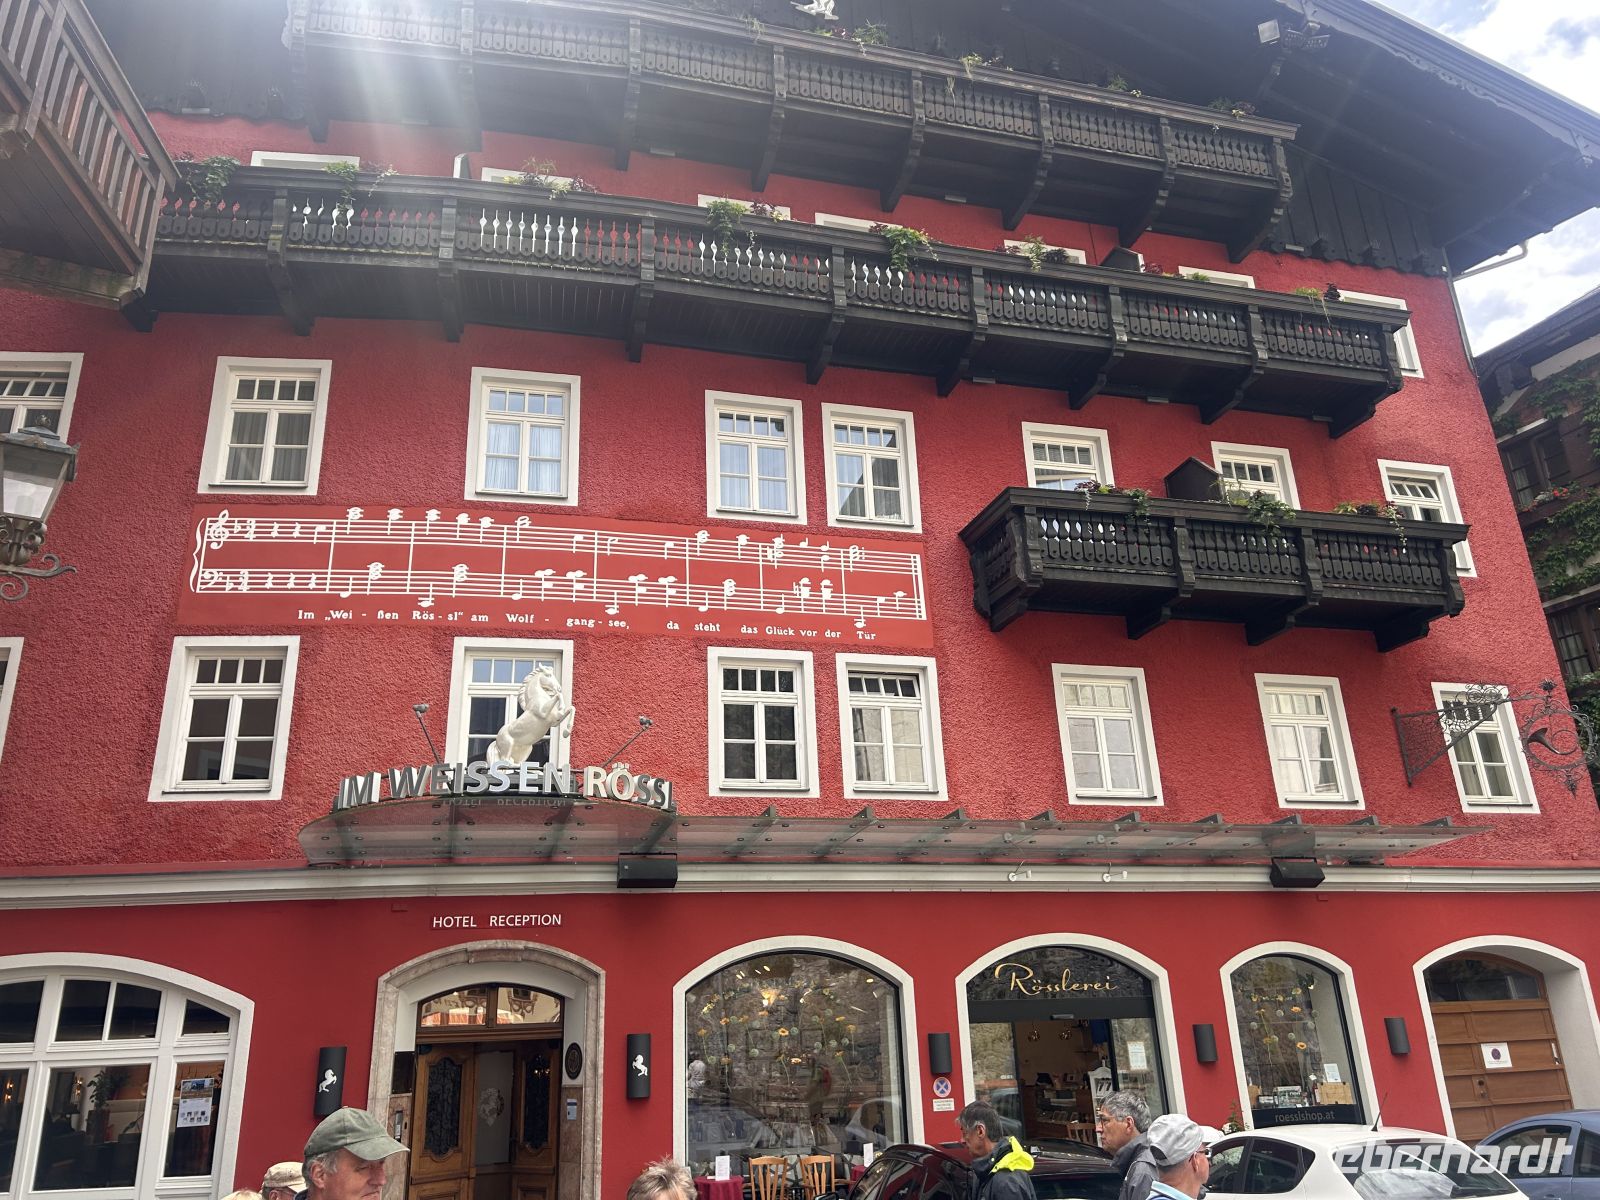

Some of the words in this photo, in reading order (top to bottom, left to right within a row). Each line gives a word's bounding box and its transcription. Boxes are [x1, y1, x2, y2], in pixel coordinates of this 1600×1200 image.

[297, 609, 315, 620] Im
[377, 609, 399, 620] ßen
[470, 614, 489, 622] am
[505, 613, 535, 624] Wolf
[608, 619, 630, 630] see,
[666, 620, 680, 630] da
[694, 622, 721, 632] steht
[740, 624, 759, 634] das
[765, 625, 796, 636] Glück
[799, 629, 818, 637] vor
[824, 628, 842, 639] der
[856, 630, 877, 640] Tür
[337, 771, 381, 809] IM
[387, 759, 571, 799] WEISSEN
[583, 762, 677, 812] RÖSSL
[432, 915, 478, 928] HOTEL
[489, 913, 563, 928] RECEPTION
[994, 962, 1118, 996] Rösslerei
[1274, 1110, 1336, 1123] roesslshop.at
